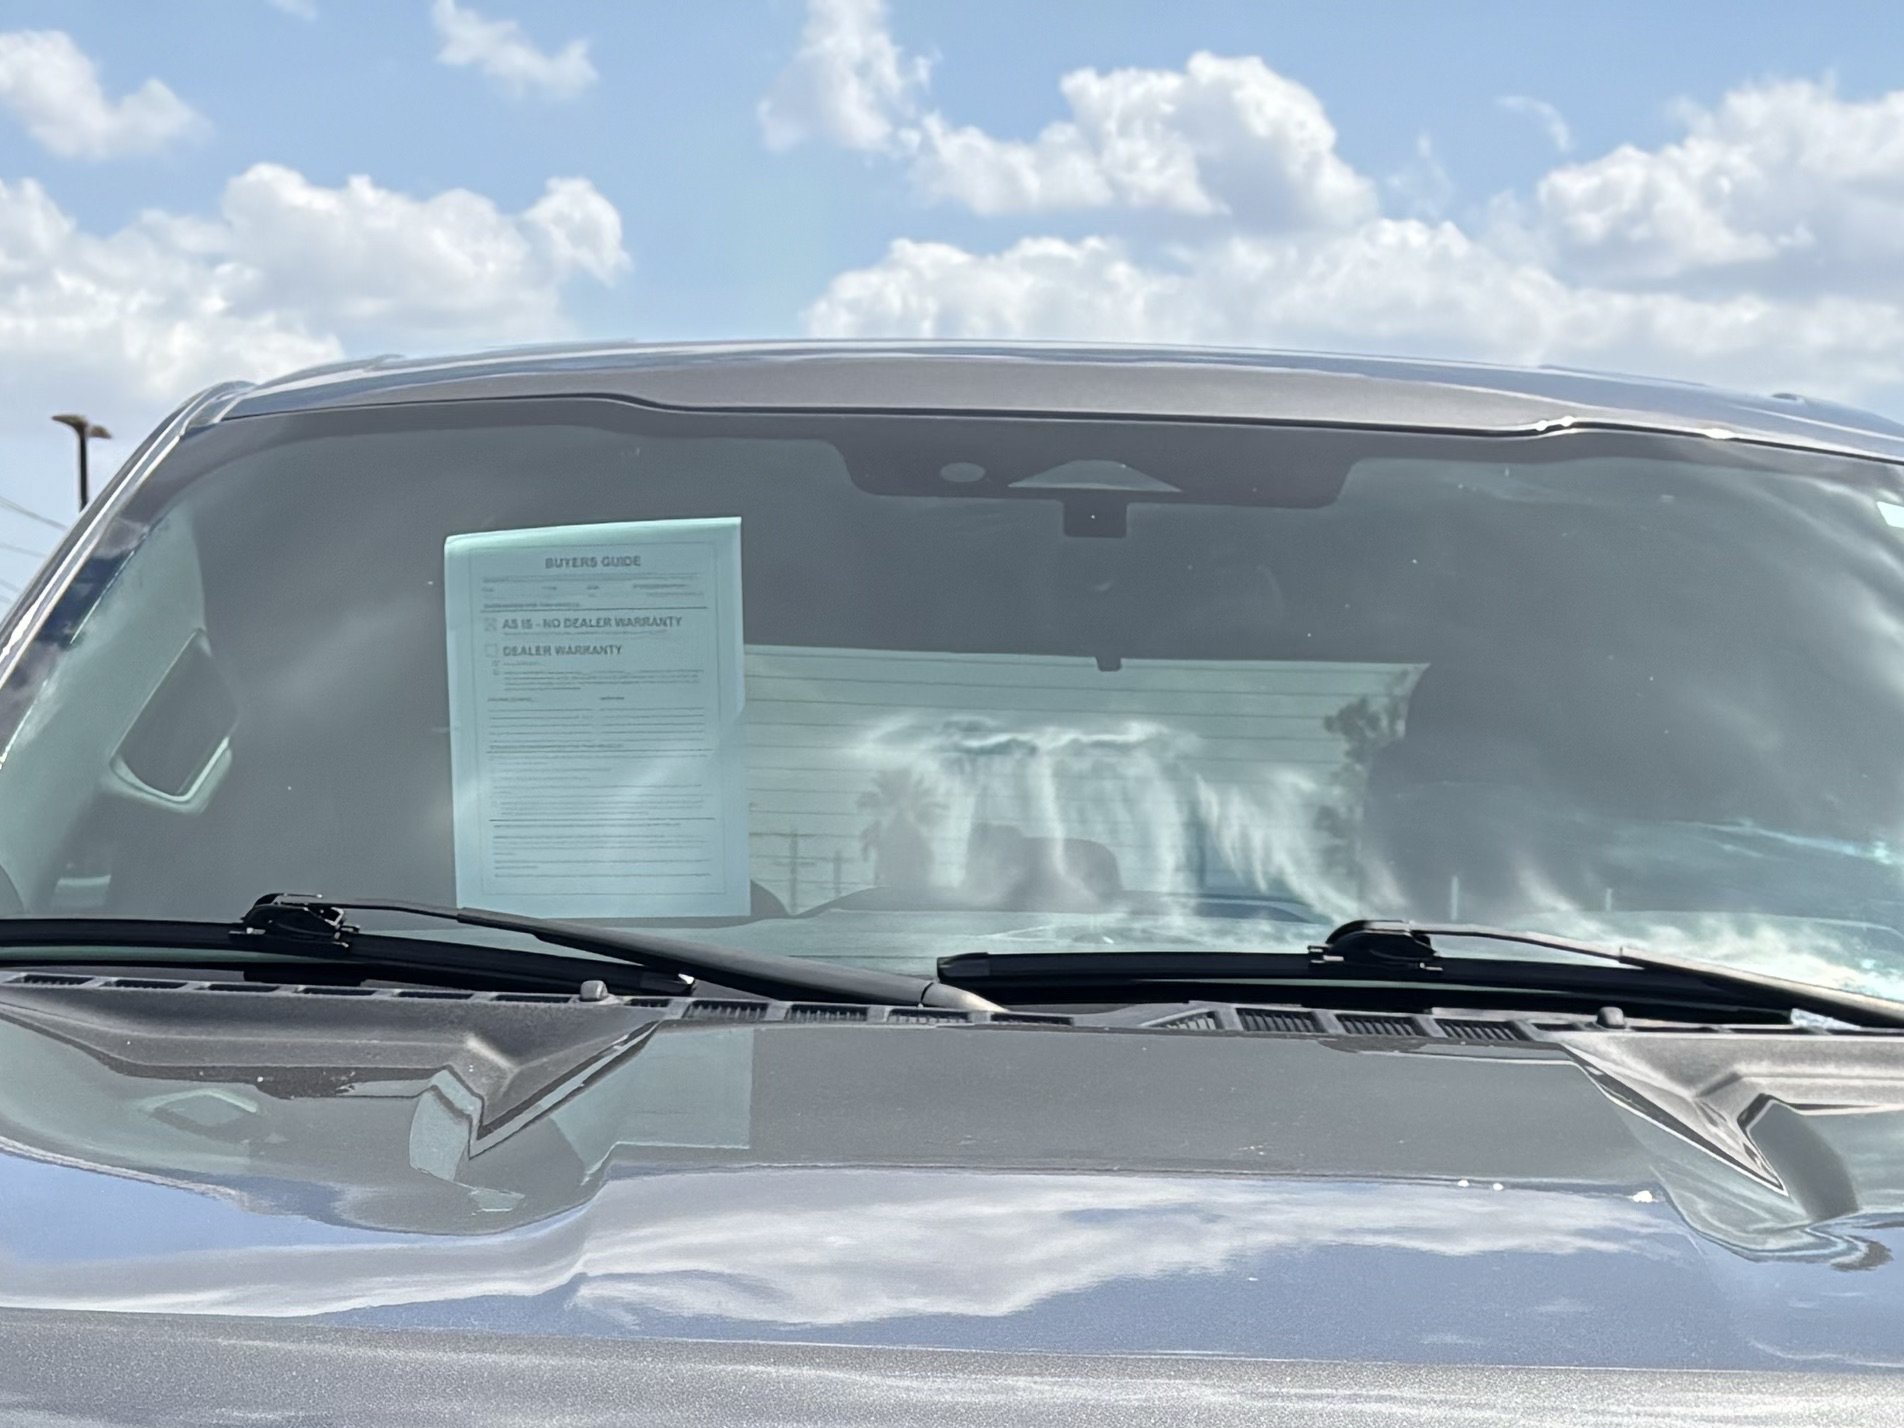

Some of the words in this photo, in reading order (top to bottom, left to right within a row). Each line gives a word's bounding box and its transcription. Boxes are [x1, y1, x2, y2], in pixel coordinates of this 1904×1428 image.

[545, 556, 597, 569] BUYERS
[601, 555, 641, 568] GUIDE
[502, 618, 519, 630] AS
[521, 618, 533, 630] IS
[543, 617, 561, 629] NO
[564, 616, 612, 629] DEALER
[615, 615, 682, 628] WARRANTY
[502, 645, 551, 658] DEALER
[555, 644, 622, 657] WARRANTY
